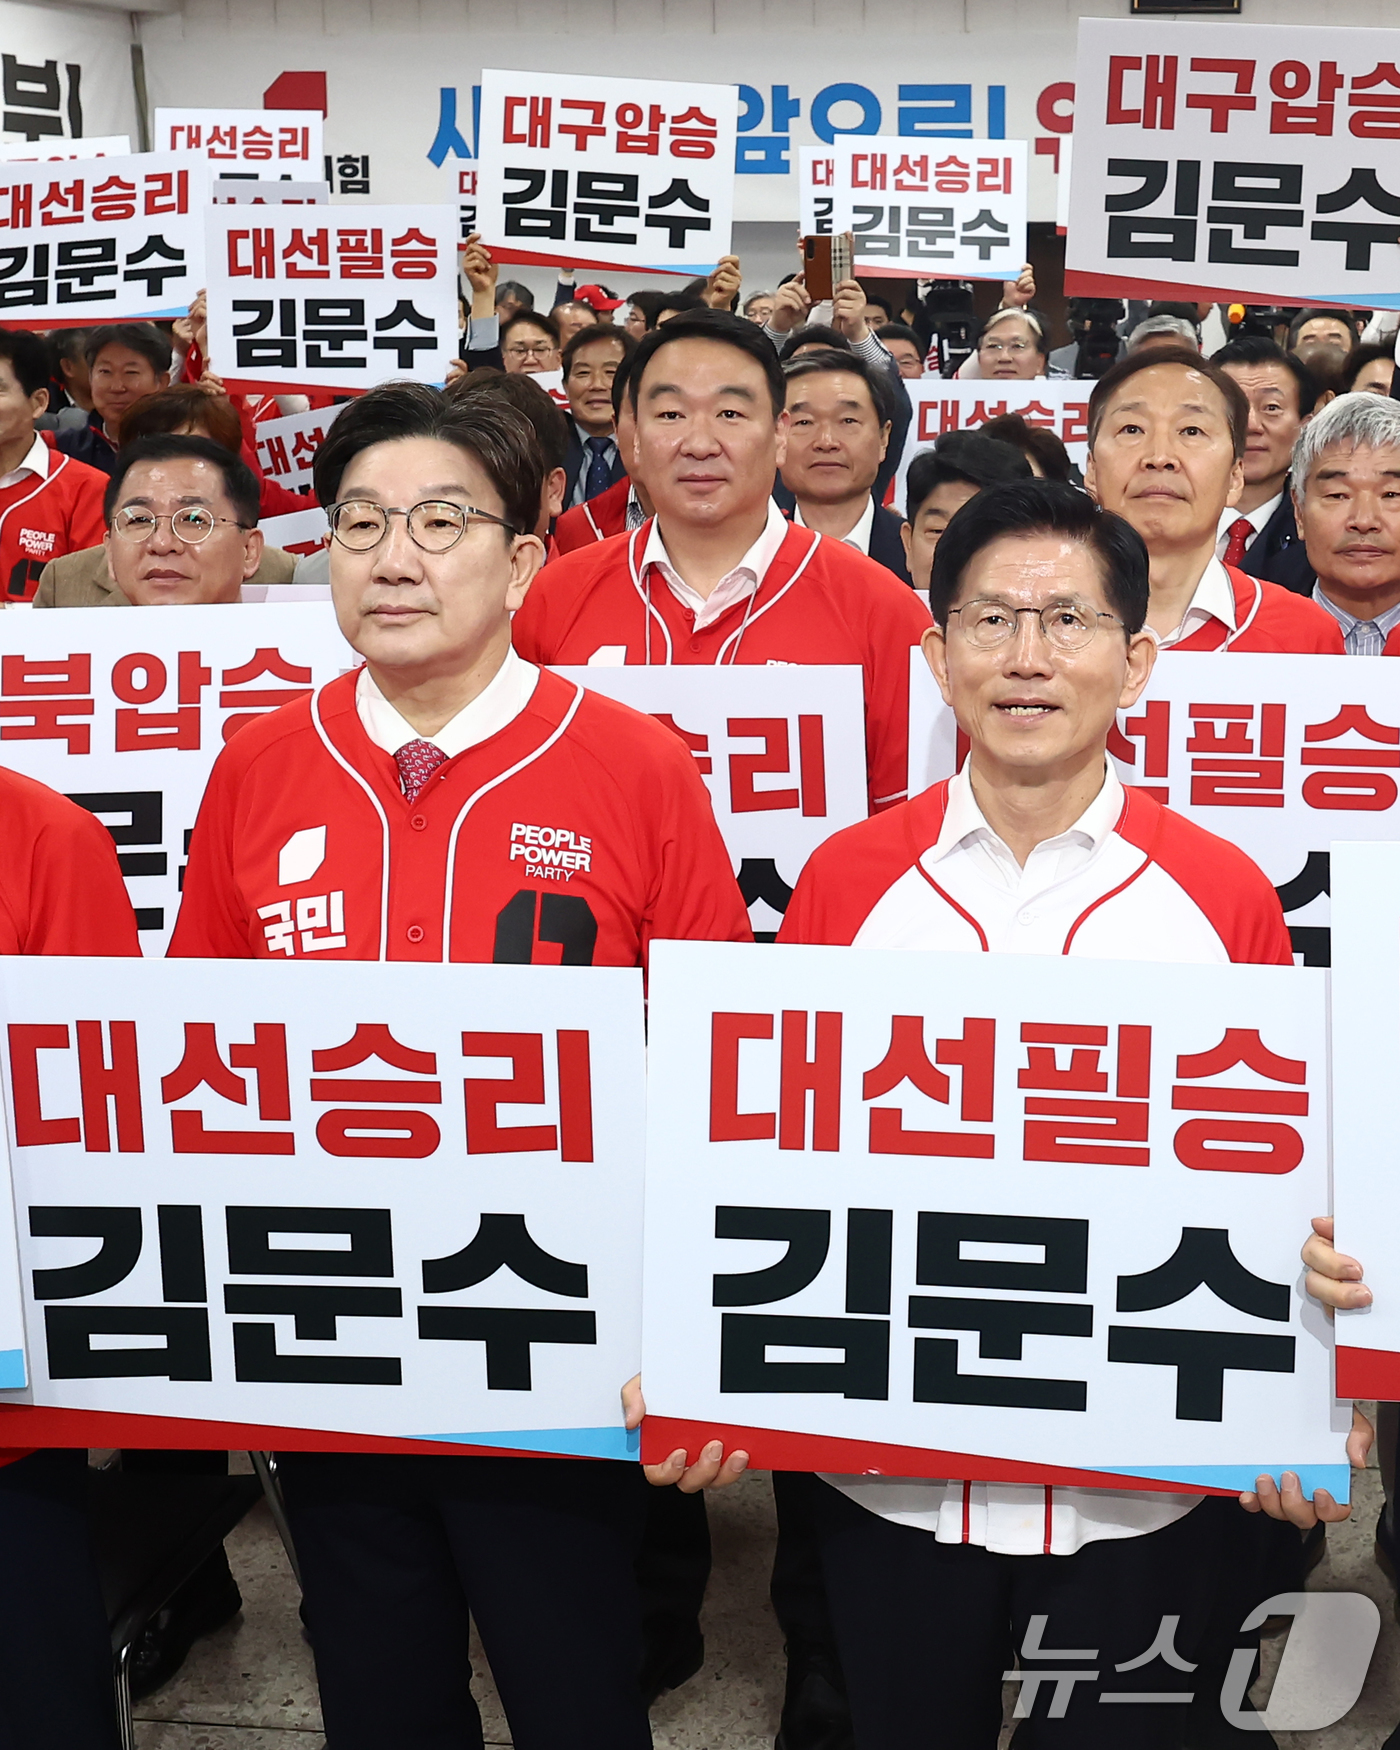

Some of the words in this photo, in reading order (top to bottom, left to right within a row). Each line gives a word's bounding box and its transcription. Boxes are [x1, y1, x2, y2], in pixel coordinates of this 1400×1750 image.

[502, 96, 718, 160] 대구압승
[1106, 54, 1400, 139] 대구압승
[170, 125, 309, 160] 대선승리
[851, 153, 1012, 194] 대선승리
[0, 170, 189, 230] 대선승리
[502, 167, 711, 249] 김문수
[1105, 158, 1400, 272] 김문수
[227, 228, 437, 280] 대선필승
[852, 205, 1010, 260] 김문수
[0, 234, 187, 309] 김문수
[232, 298, 438, 369] 김문수
[19, 537, 53, 552] POWER
[20, 527, 55, 543] PEOPLE
[509, 842, 591, 872] POWER
[510, 822, 593, 854] PEOPLE
[525, 864, 574, 882] PARTY
[256, 890, 347, 957] 국민
[7, 1019, 594, 1163] 대선승리
[709, 1009, 1309, 1175] 대선필승
[28, 1204, 597, 1391] 김문수
[712, 1205, 1296, 1422] 김문수
